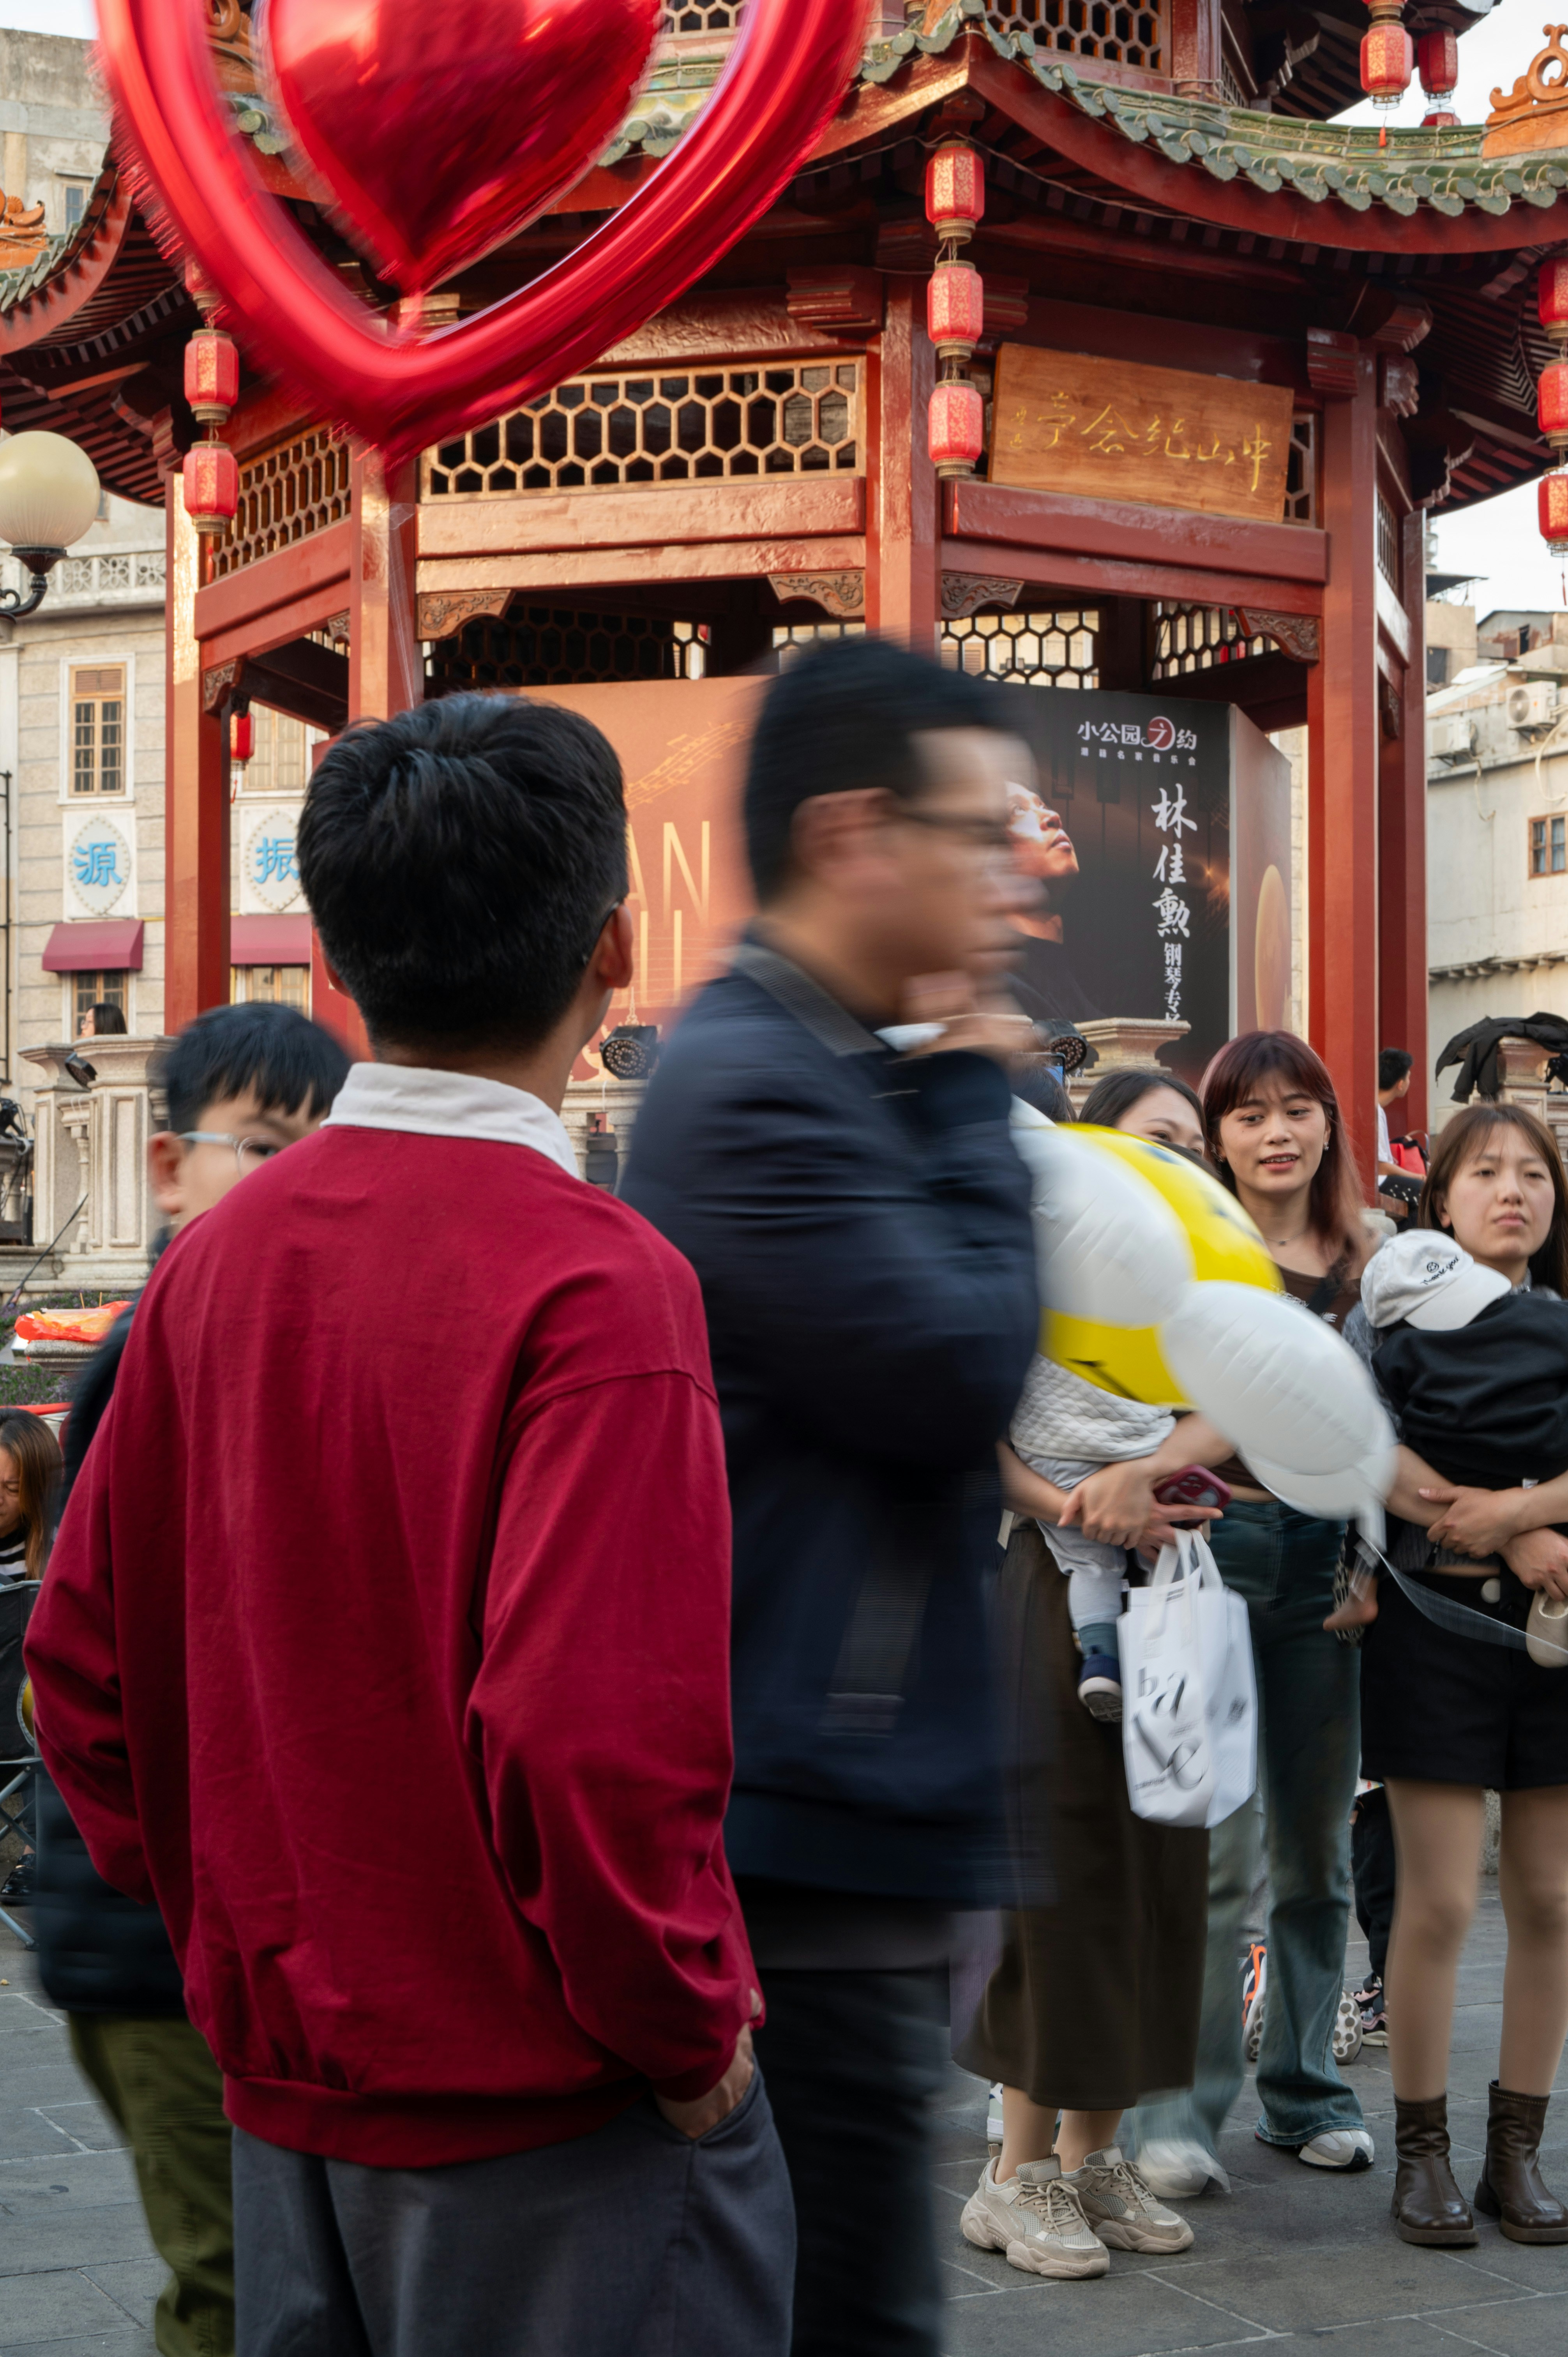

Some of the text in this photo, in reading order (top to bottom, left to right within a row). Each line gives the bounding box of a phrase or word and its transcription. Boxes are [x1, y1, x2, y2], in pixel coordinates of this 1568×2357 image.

[1077, 716, 1197, 751] 小公园之约
[73, 841, 122, 887] 源
[253, 837, 300, 884] 振
